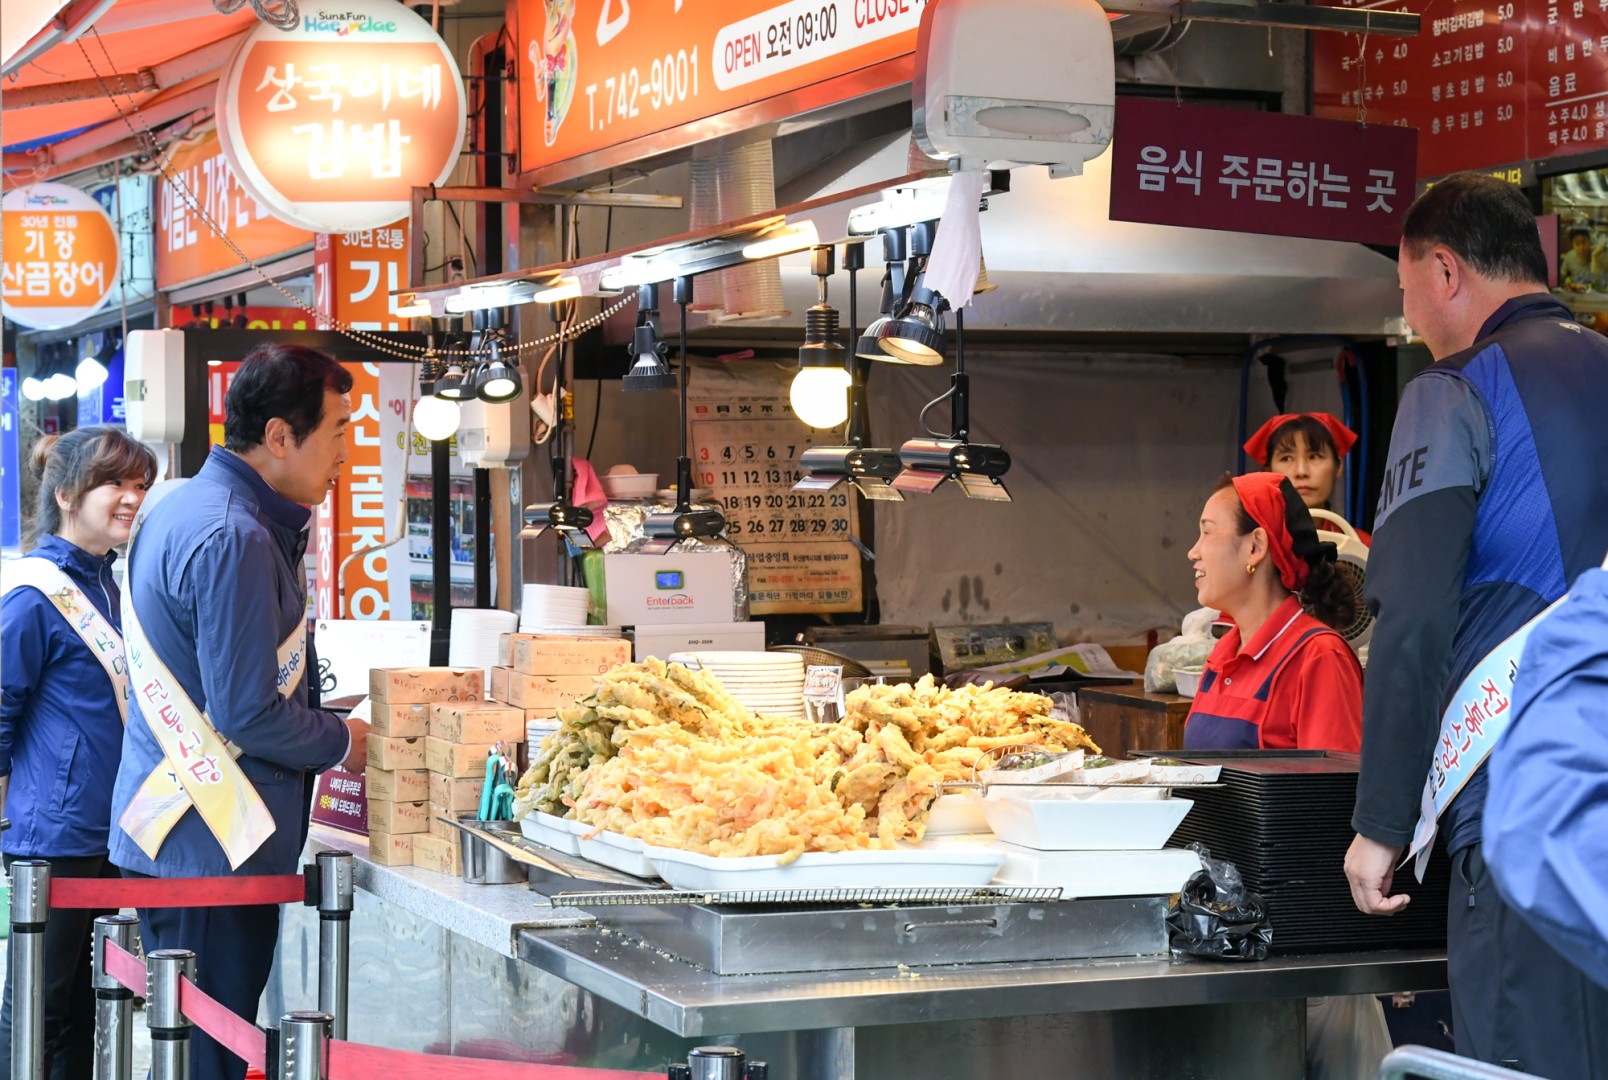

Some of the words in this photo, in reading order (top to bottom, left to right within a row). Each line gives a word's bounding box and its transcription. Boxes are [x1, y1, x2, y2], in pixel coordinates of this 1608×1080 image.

[304, 15, 398, 36] Haeundae
[319, 11, 367, 21] Sun&Fun
[854, 0, 910, 29] CLOSE
[1432, 9, 1484, 37] 참치김치김밥
[1497, 3, 1514, 21] 5.0
[724, 31, 762, 74] OPEN
[766, 17, 792, 59] 오전
[796, 3, 838, 50] 09:00
[1393, 43, 1408, 60] 4.0
[1432, 42, 1485, 68] 소고기김밥
[1497, 36, 1514, 54] 5.0
[256, 62, 443, 112] 상국이네
[585, 45, 699, 131] T.742-9001
[1393, 79, 1408, 96] 5.0
[1497, 71, 1513, 88] 5.0
[1549, 72, 1576, 98] 음료
[1497, 104, 1513, 121] 5.0
[1548, 107, 1569, 126] 소주
[1571, 103, 1588, 121] 4.0
[1572, 125, 1588, 142] 4.0
[290, 118, 411, 180] 김밥
[1136, 144, 1203, 196] 음식
[1219, 153, 1352, 210] 주문하는
[1365, 168, 1397, 214] 곳
[161, 164, 199, 253] 이름난
[342, 229, 373, 248] 30년
[375, 228, 405, 250] 전통
[2, 261, 104, 298] 산곰장어
[700, 447, 709, 461] 3
[723, 446, 732, 460] 4
[745, 446, 754, 459] 5
[767, 446, 776, 459] 6
[787, 446, 796, 458] 7
[700, 472, 714, 485] 10
[722, 471, 736, 484] 11
[744, 471, 760, 484] 12
[765, 471, 780, 484] 13
[787, 470, 800, 483] 14
[724, 496, 739, 509] 18
[746, 496, 761, 509] 19
[767, 495, 782, 508] 20
[789, 495, 802, 508] 21
[809, 495, 825, 508] 22
[830, 494, 847, 507] 23
[726, 521, 742, 534] 25
[747, 521, 764, 534] 26
[769, 520, 784, 533] 27
[790, 520, 805, 533] 28
[810, 520, 826, 532] 29
[832, 519, 848, 532] 30
[646, 596, 694, 606] Enterpack
[142, 677, 221, 784] 전통시장
